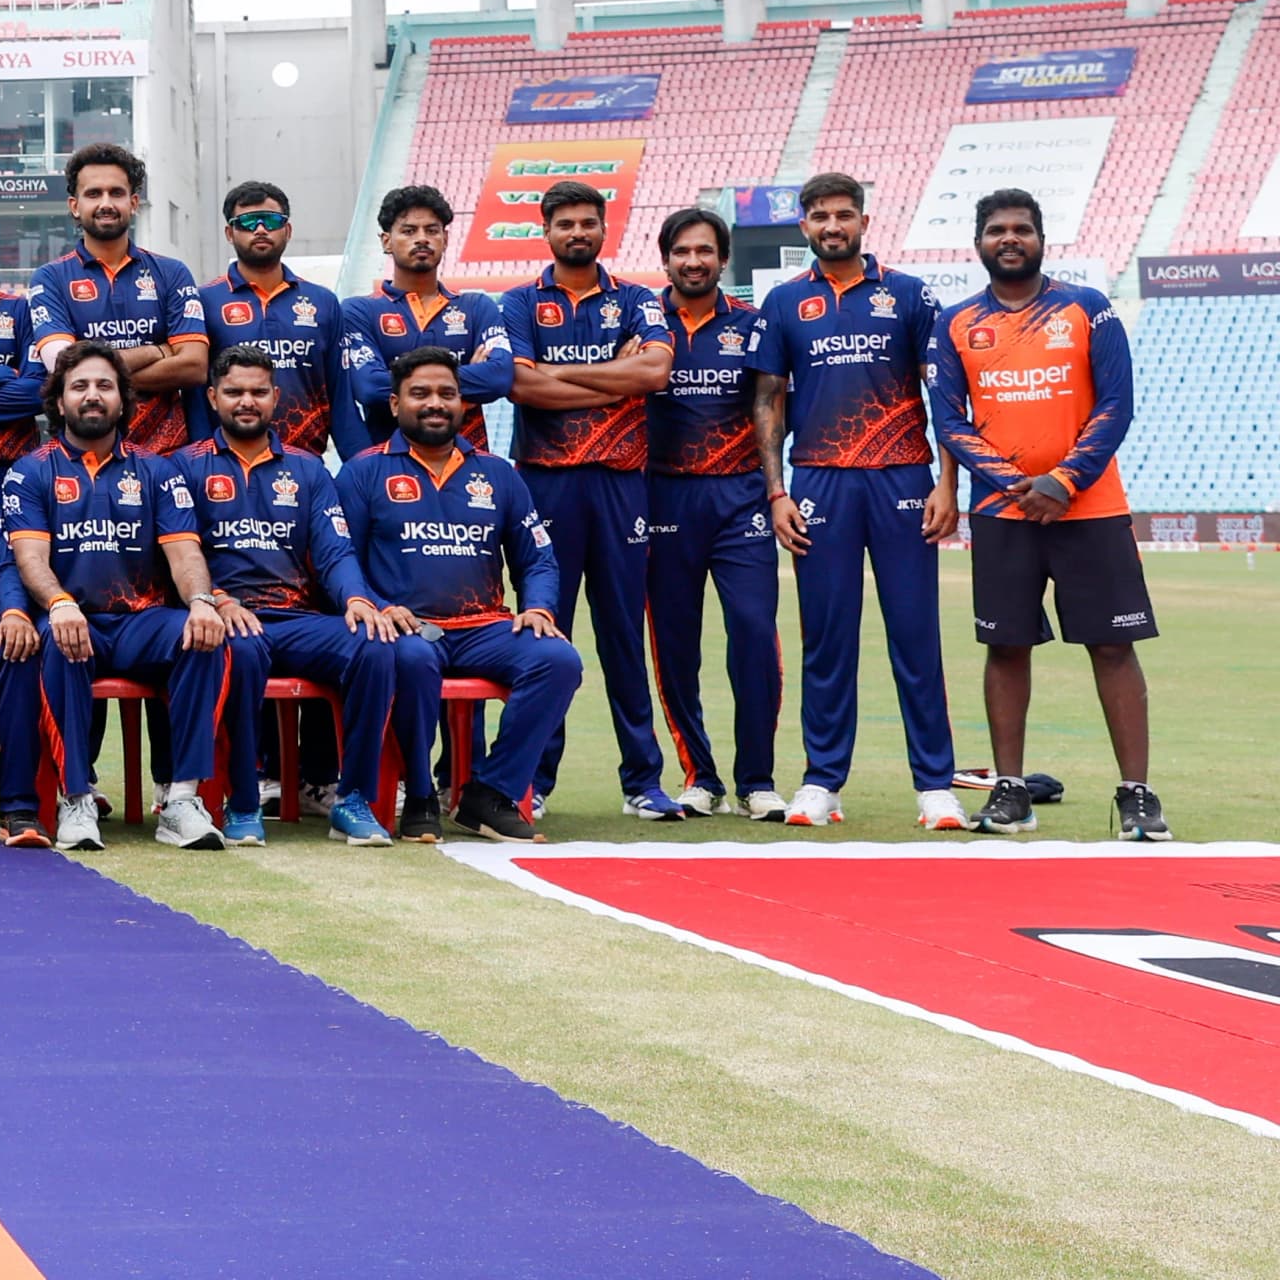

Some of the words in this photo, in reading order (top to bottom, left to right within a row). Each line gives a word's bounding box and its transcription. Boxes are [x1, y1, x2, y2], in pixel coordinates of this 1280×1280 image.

[63, 50, 136, 68] SURYA
[984, 138, 1092, 151] TRENDS
[1147, 264, 1220, 281] LAQSHYA
[826, 352, 874, 365] cement
[673, 385, 722, 396] cement
[996, 388, 1052, 402] cement
[234, 537, 280, 550] cement
[422, 544, 477, 556] cement
